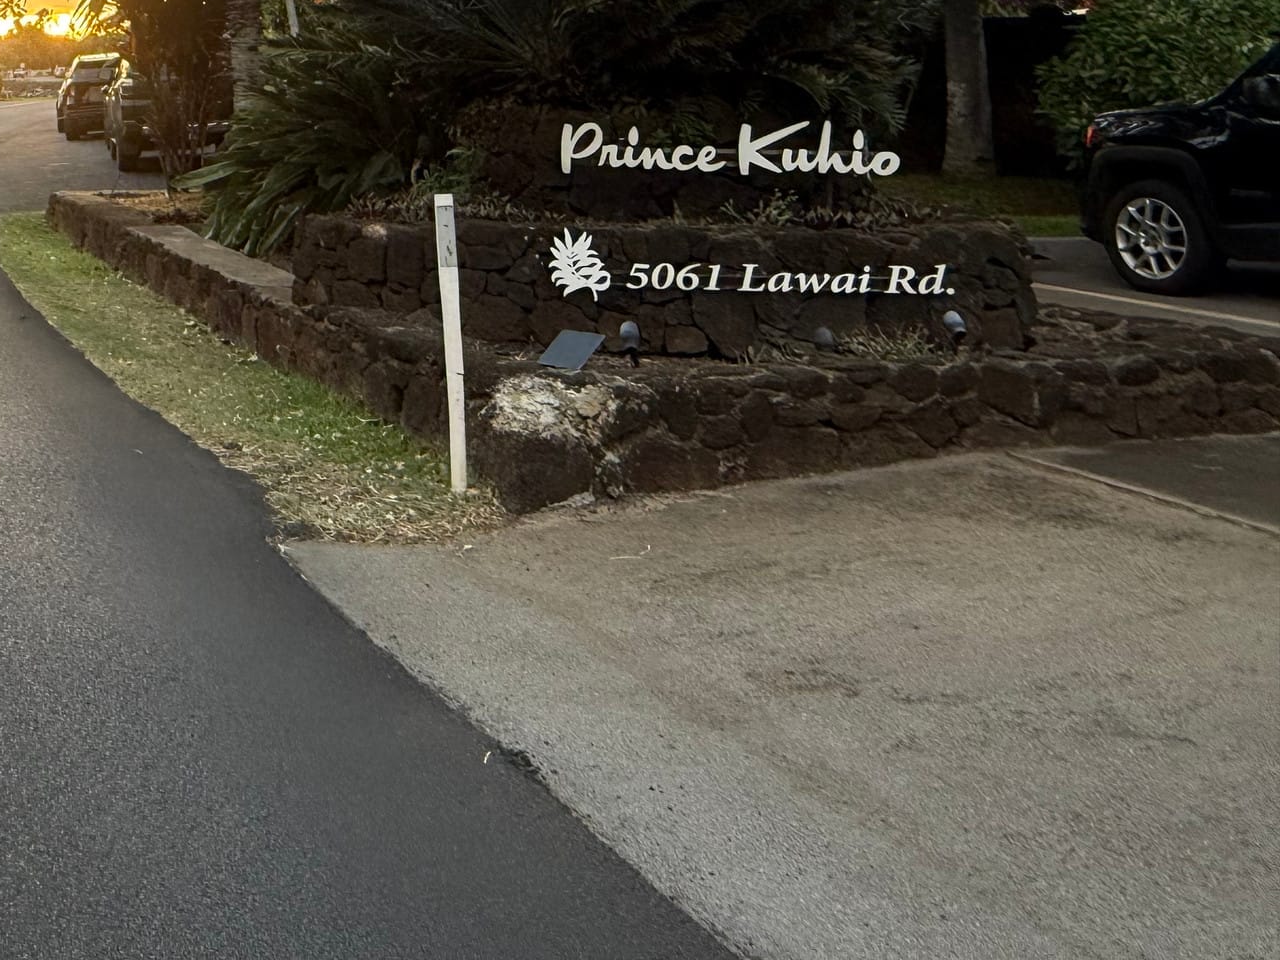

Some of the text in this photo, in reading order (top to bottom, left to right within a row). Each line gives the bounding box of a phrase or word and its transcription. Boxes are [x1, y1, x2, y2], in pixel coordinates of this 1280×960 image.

[560, 120, 901, 176] Prince Kuhio
[625, 262, 955, 295] 5061 Lawai Rd.
